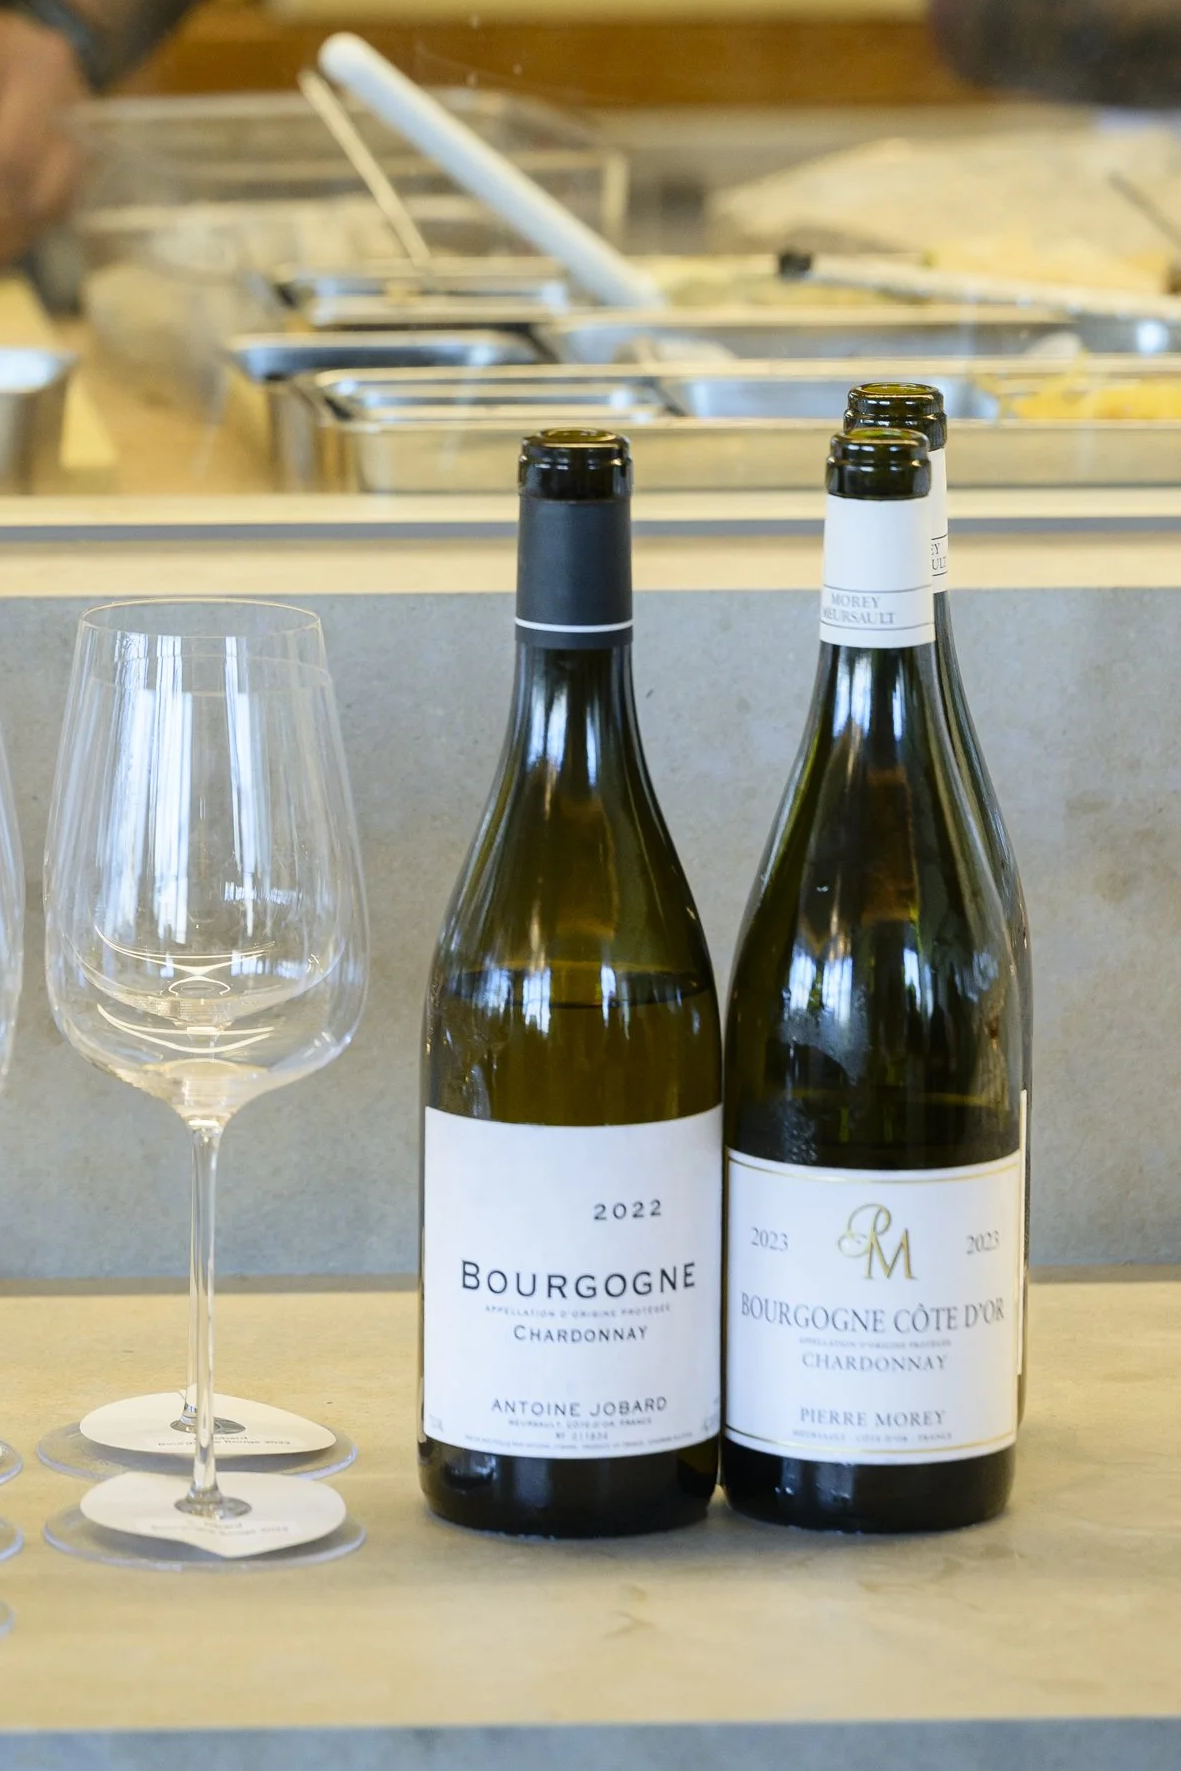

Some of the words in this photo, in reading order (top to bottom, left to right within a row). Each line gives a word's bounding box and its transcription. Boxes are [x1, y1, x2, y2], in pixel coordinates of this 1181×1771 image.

[831, 593, 880, 608] MOREY
[593, 1199, 662, 1220] 2022
[750, 1227, 789, 1252] 2023
[966, 1230, 1000, 1256] 2023
[461, 1259, 696, 1300] BOURGOGNE
[741, 1292, 886, 1333] BOURGOGNE
[894, 1303, 957, 1334] CÔTE
[964, 1298, 1005, 1328] D'OR
[513, 1324, 648, 1343] CHARDONNAY
[802, 1352, 947, 1372] CHARDONNAY
[491, 1398, 581, 1417] ANTOINE
[589, 1396, 668, 1417] JOBARD
[800, 1406, 867, 1427] PIERRE
[875, 1409, 946, 1428] MOREY
